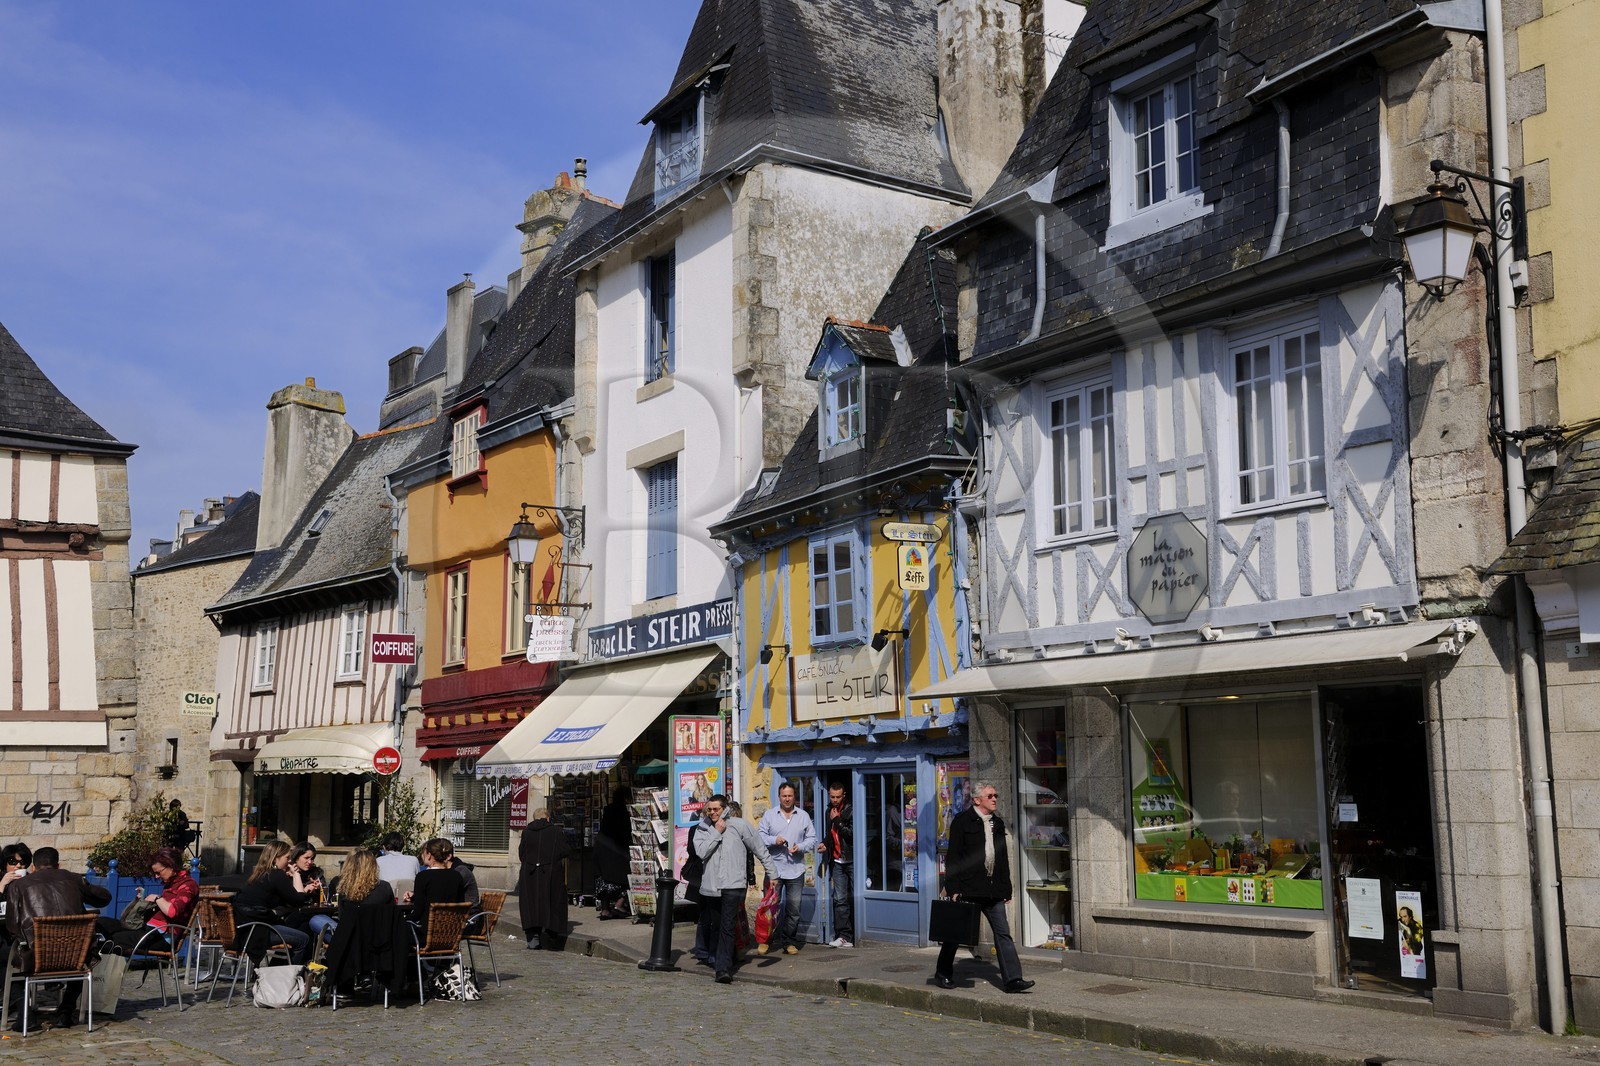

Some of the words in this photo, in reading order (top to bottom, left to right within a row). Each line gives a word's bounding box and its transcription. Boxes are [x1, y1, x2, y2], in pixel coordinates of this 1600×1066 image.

[891, 528, 904, 538] Le
[908, 530, 935, 540] Steir
[1140, 547, 1194, 568] maison
[905, 570, 925, 584] Leffe
[1162, 563, 1176, 577] du
[1151, 572, 1199, 604] papier
[618, 625, 637, 652] LE
[647, 611, 701, 648] STEIR
[373, 640, 414, 656] COIFFURE
[1574, 645, 1580, 655] 3
[797, 664, 817, 680] CAFÉ
[818, 661, 845, 677] SNACK
[815, 680, 838, 705] LE
[841, 673, 892, 702] STEIR
[184, 692, 214, 705] Cléo
[559, 727, 600, 741] FIGARO
[456, 746, 480, 756] COIFFURE
